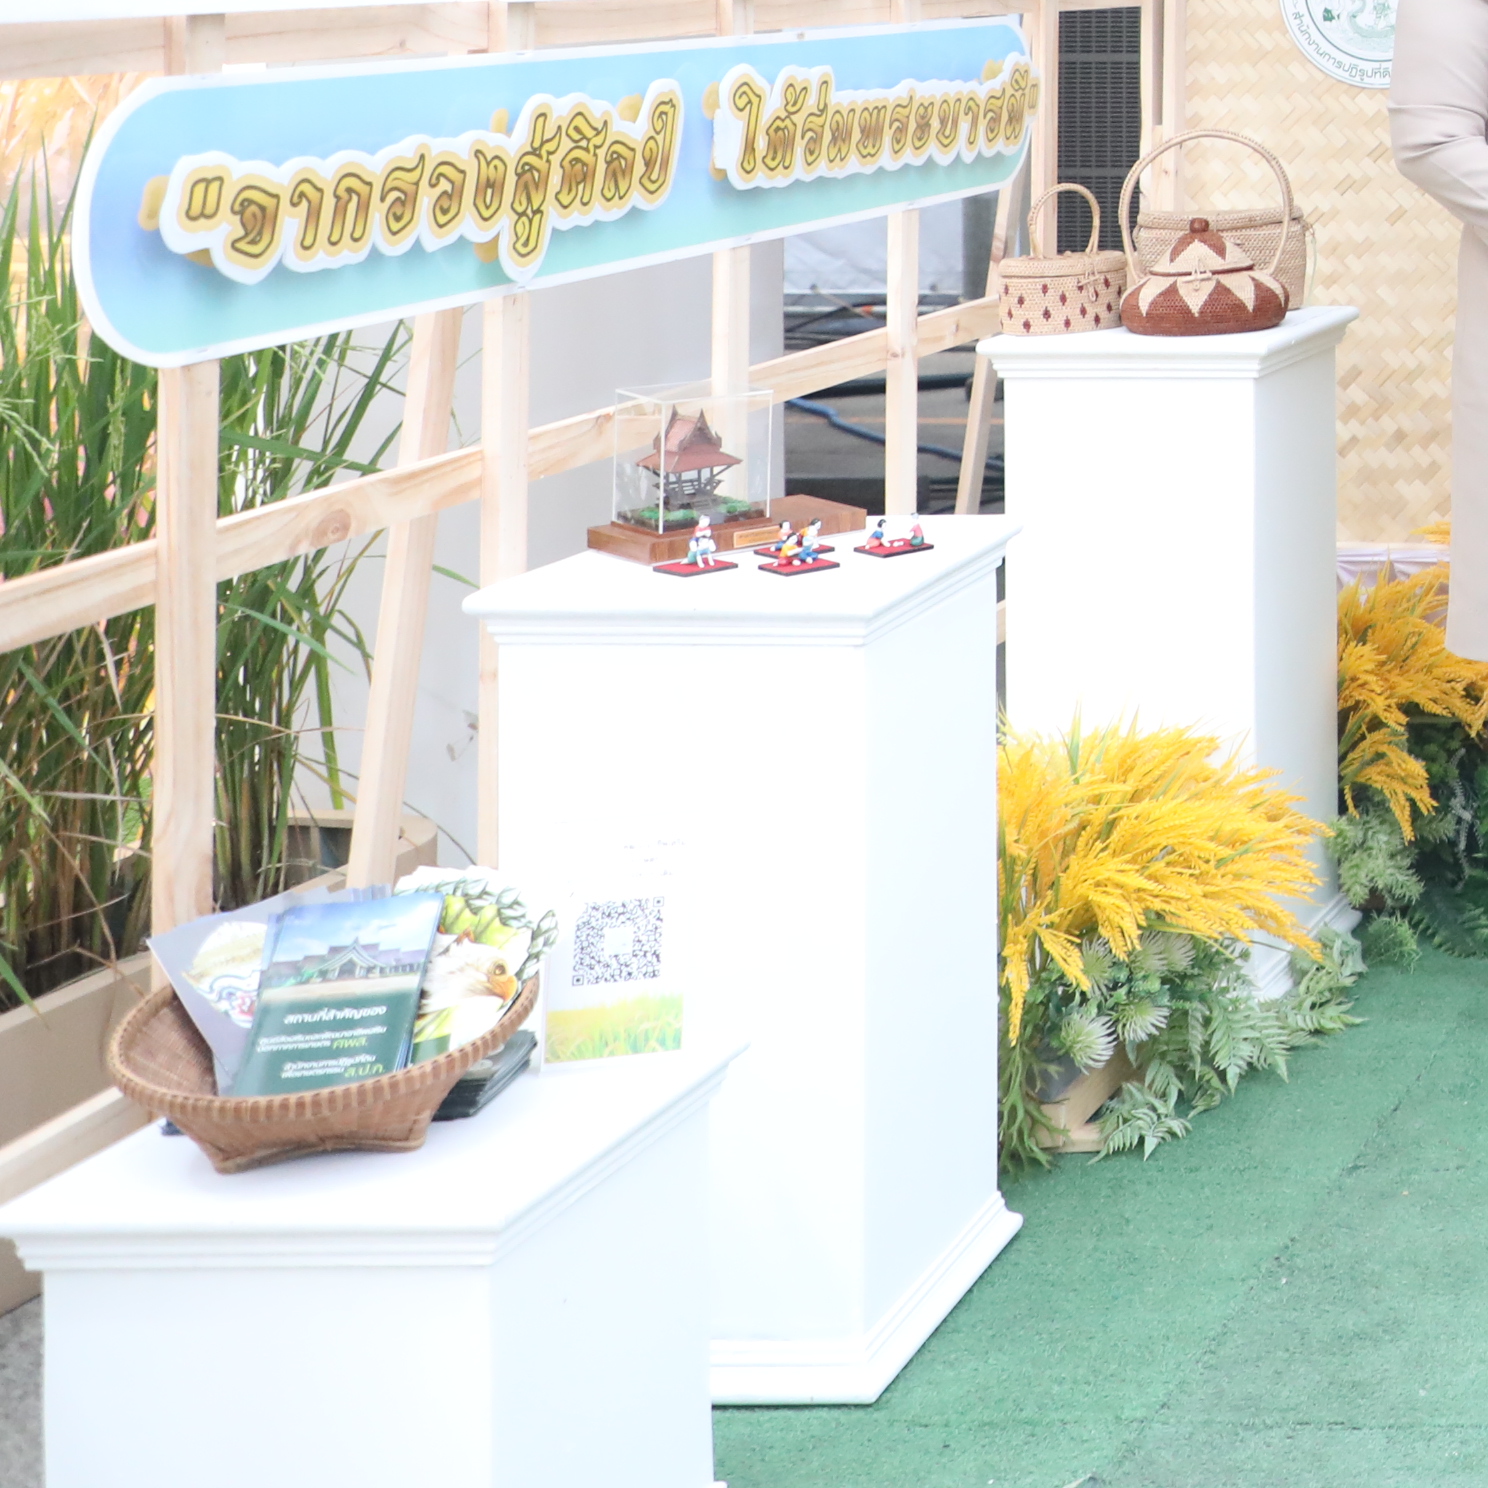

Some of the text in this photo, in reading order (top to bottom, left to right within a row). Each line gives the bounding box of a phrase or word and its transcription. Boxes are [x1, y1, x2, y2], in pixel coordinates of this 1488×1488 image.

[1292, 11, 1391, 82] สำนักงานการปฏิรูปที่ดิ
[186, 69, 1039, 261] "จากรวงสู่ศิลป์ ใต้ร่มพระบารมี"
[283, 1005, 387, 1025] สถานที่สำคัญของ
[344, 1063, 386, 1078] ส.ป.ก.
